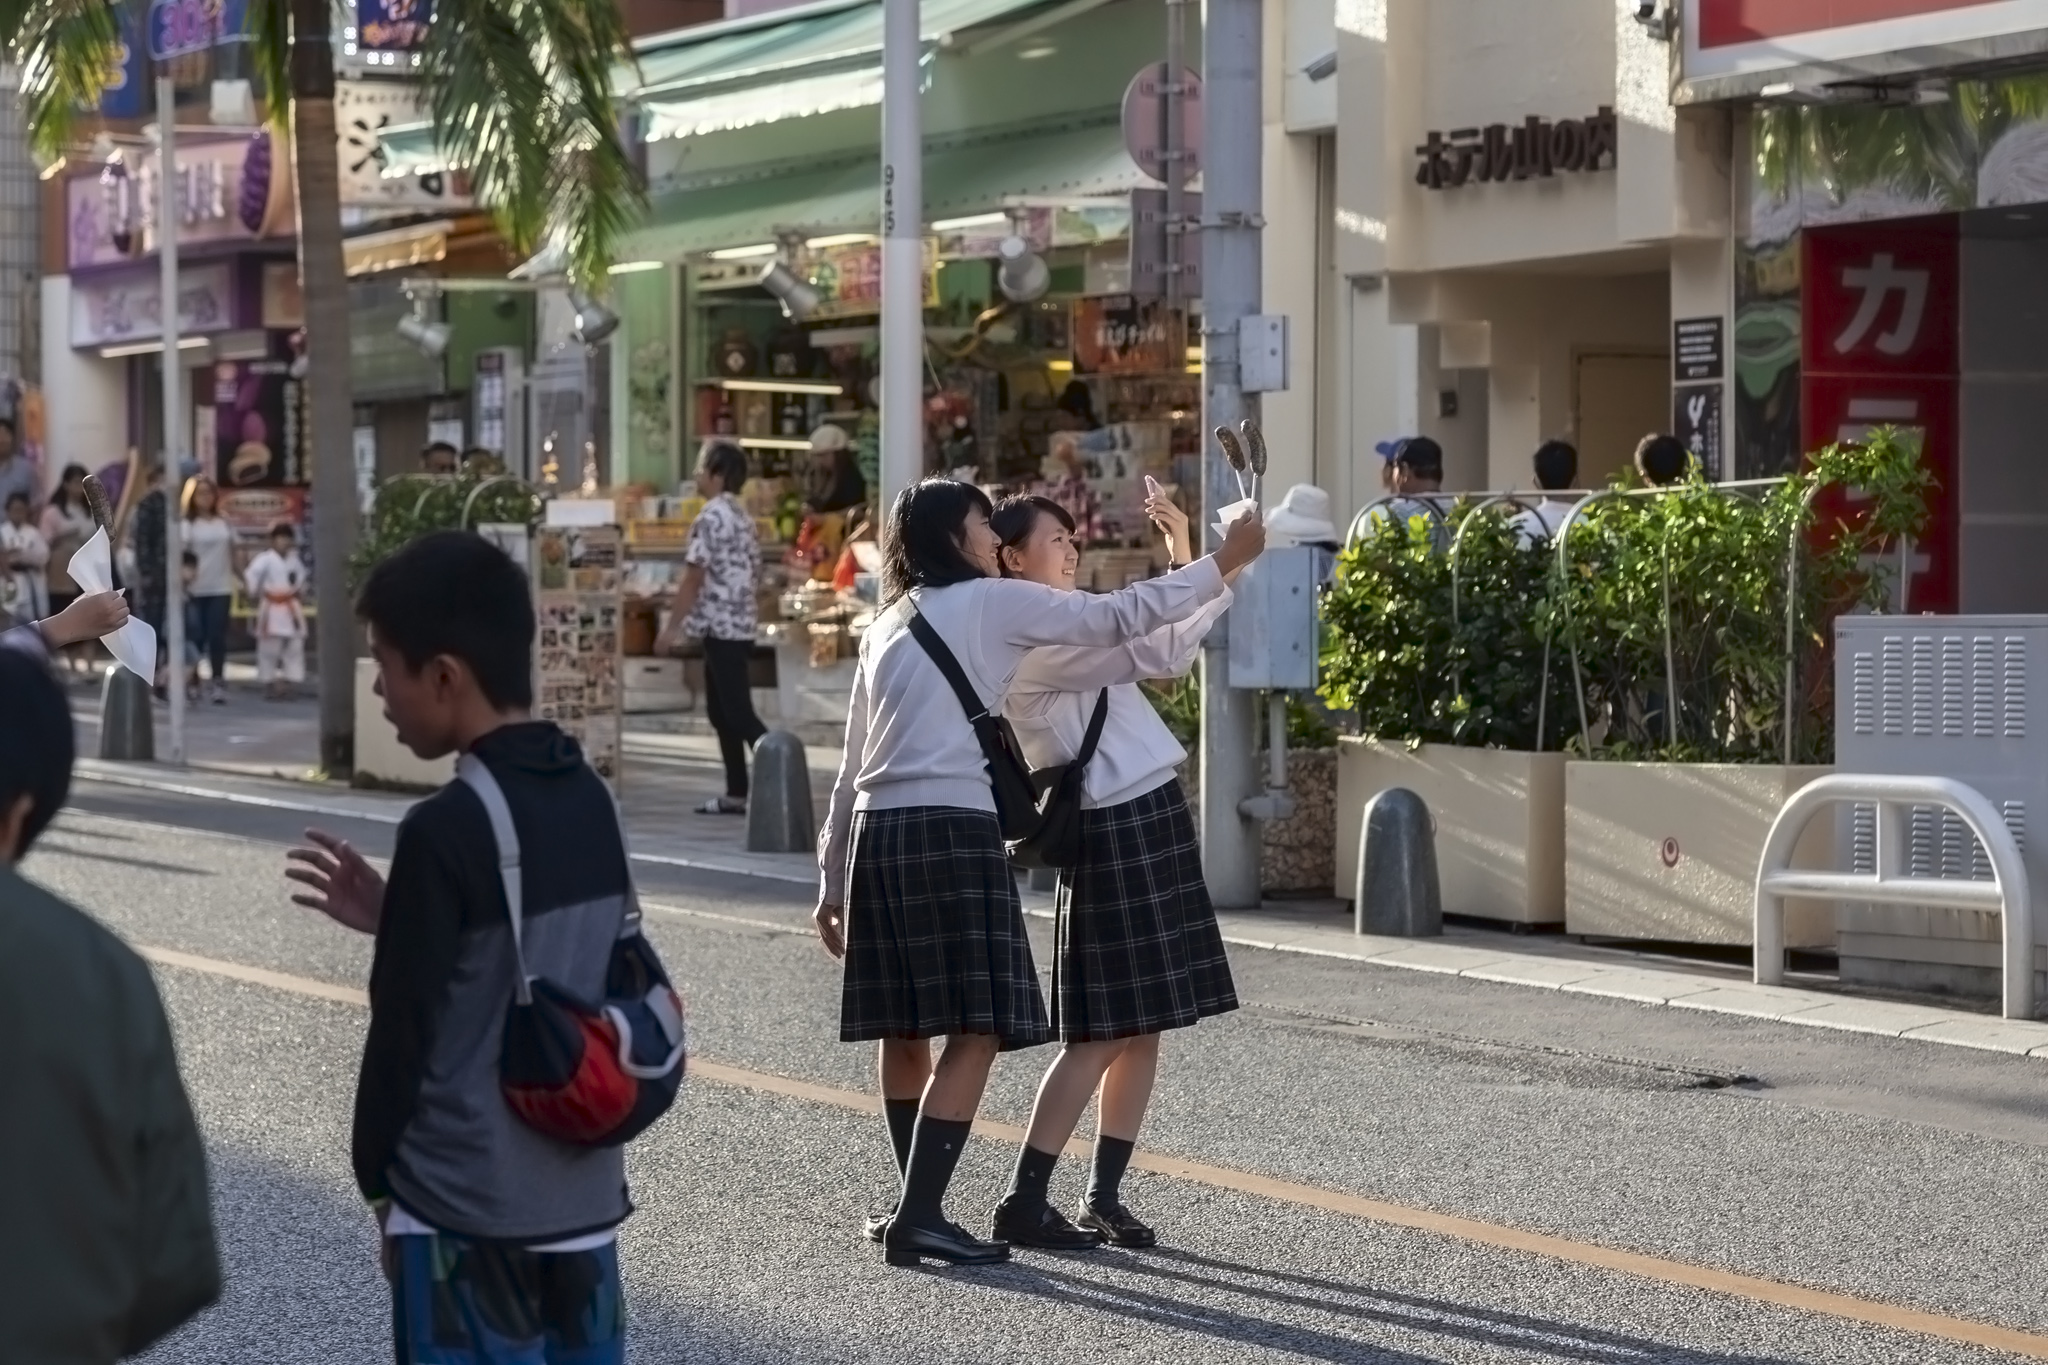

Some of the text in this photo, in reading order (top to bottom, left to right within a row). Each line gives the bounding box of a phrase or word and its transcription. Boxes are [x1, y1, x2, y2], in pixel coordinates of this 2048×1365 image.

[1416, 106, 1617, 189] ホテル山の内
